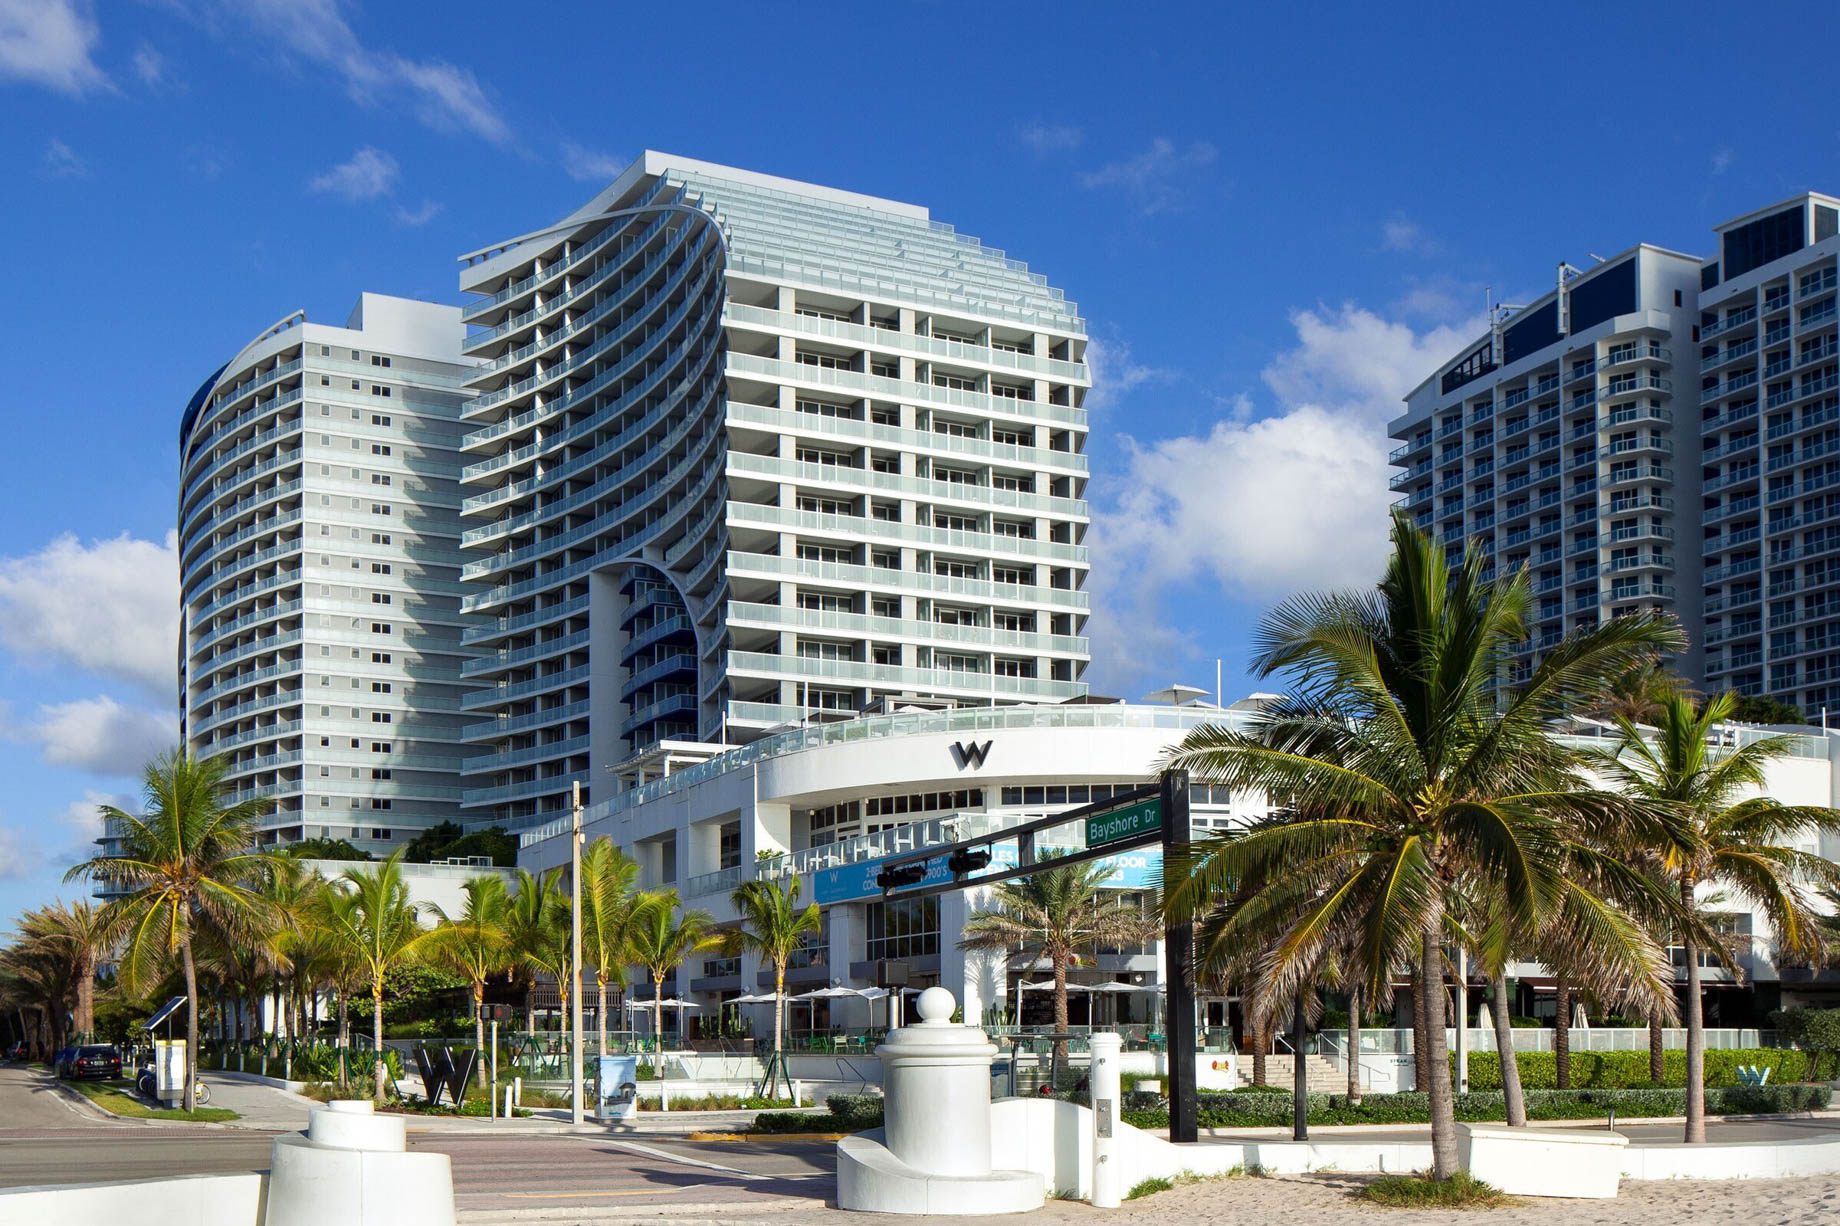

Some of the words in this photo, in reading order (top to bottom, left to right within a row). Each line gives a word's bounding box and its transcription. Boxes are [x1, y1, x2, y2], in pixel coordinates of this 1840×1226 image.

[954, 740, 993, 767] W
[1090, 814, 1139, 841] Bayshore
[1144, 808, 1156, 824] Dr
[829, 871, 839, 884] W
[412, 1047, 478, 1106] W
[1736, 1065, 1771, 1086] W
